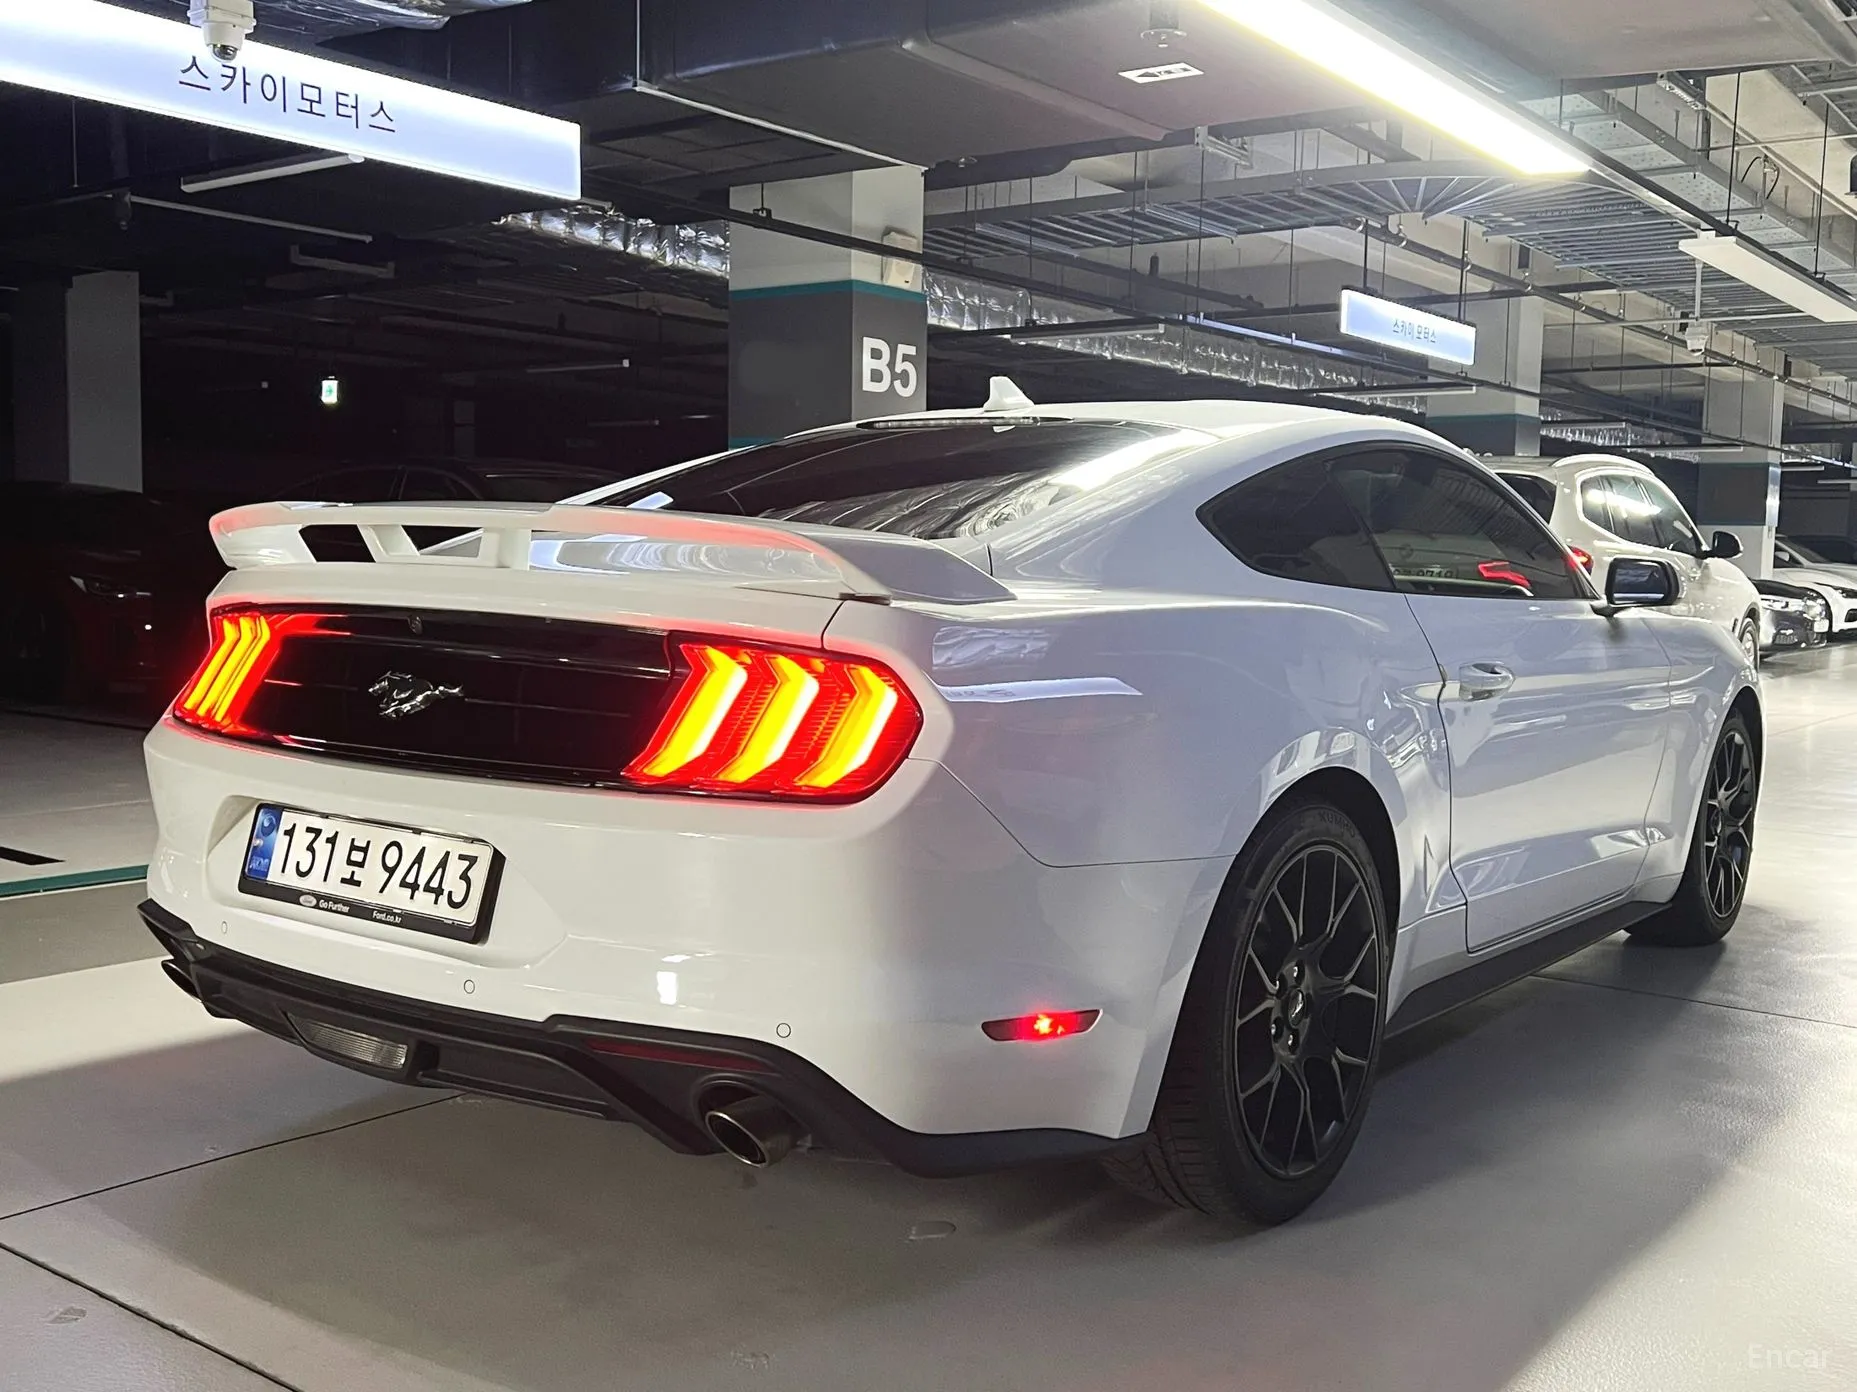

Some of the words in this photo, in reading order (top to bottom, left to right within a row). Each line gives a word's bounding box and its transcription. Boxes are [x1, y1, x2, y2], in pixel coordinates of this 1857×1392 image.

[178, 55, 396, 133] 스카이모터스
[1392, 320, 1437, 343] 스카이모터스
[862, 336, 917, 397] B5
[281, 823, 371, 888] 131보
[379, 840, 479, 910] 9443
[318, 899, 329, 909] Go
[328, 901, 351, 913] Further
[372, 910, 402, 924] Ford.co.kr
